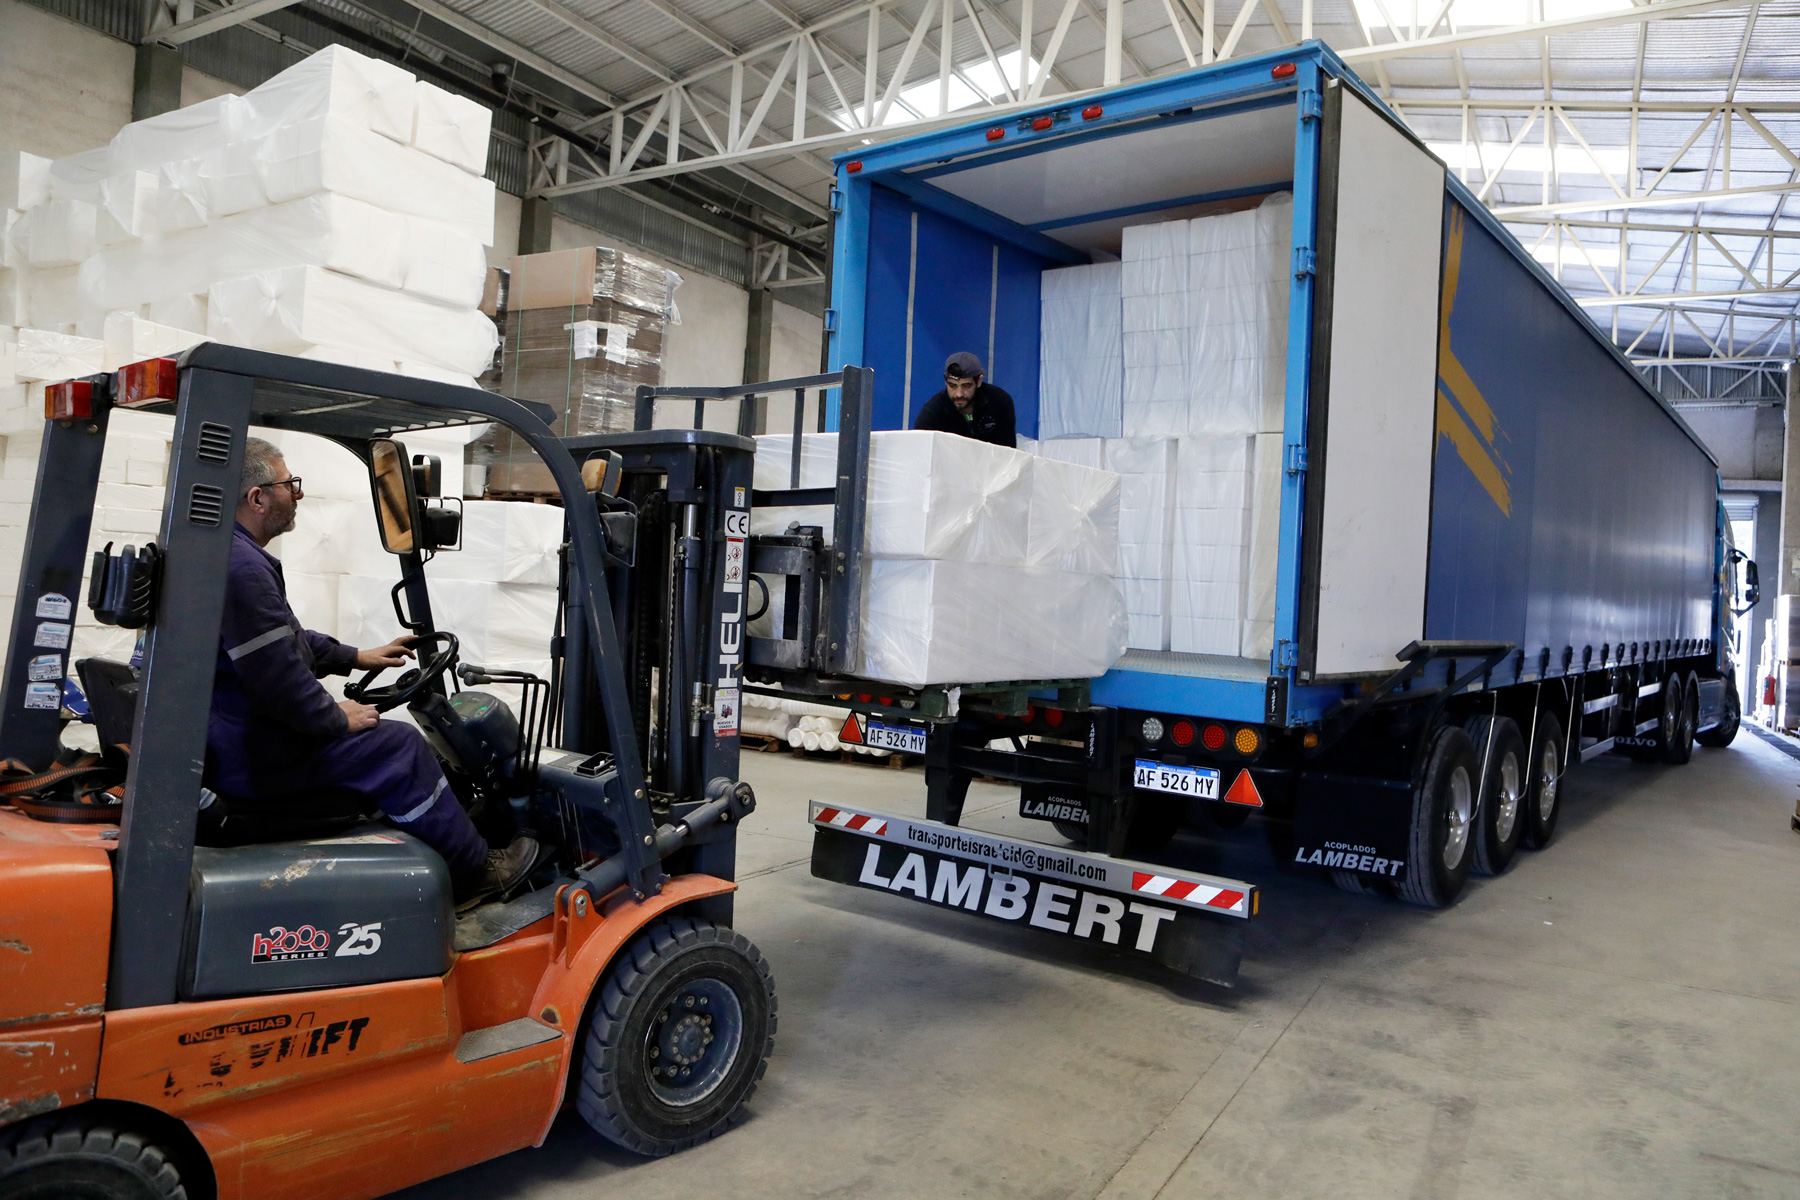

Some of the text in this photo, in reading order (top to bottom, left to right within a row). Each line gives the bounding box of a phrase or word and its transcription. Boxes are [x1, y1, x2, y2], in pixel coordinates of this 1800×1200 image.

[727, 514, 747, 534] CE
[718, 583, 742, 688] HELI
[870, 729, 924, 750] AF 526 MY
[1615, 736, 1657, 747] OLVO
[1137, 768, 1214, 795] AF 526 MY
[1023, 800, 1090, 823] LAMBER
[1048, 796, 1082, 807] ACOPLADOS
[1324, 841, 1377, 854] ACOPLADOS
[1295, 847, 1404, 876] LAMBERT
[859, 843, 1177, 953] LAMBERT
[335, 922, 382, 957] 25
[270, 951, 325, 961] SERIES
[184, 1016, 287, 1042] INDUSTRIAS
